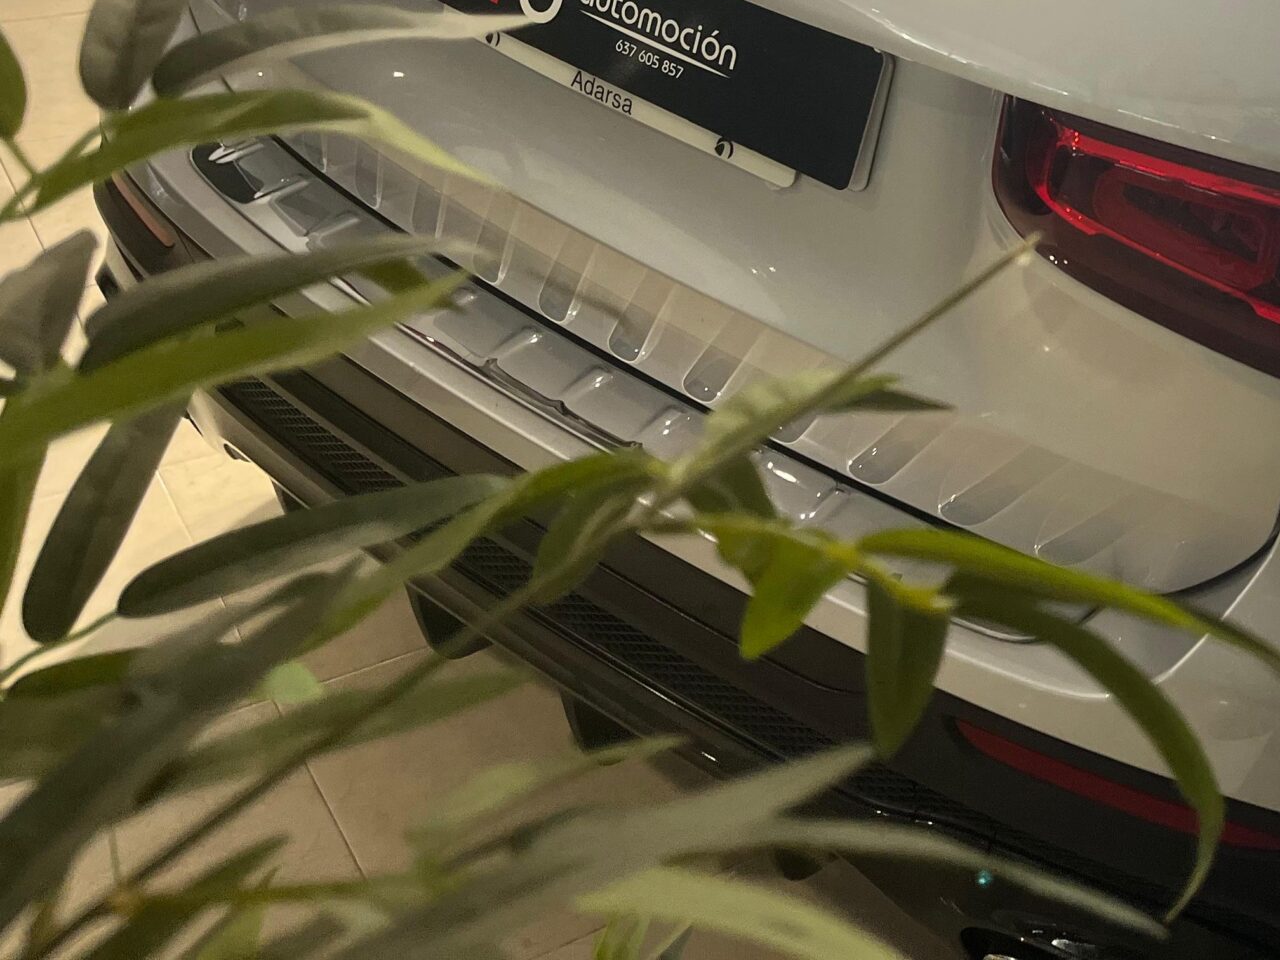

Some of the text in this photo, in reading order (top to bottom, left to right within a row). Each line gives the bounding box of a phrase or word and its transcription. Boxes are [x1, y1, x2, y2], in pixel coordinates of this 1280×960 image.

[615, 39, 684, 79] 637 605 857
[571, 70, 633, 115] Adarsa
